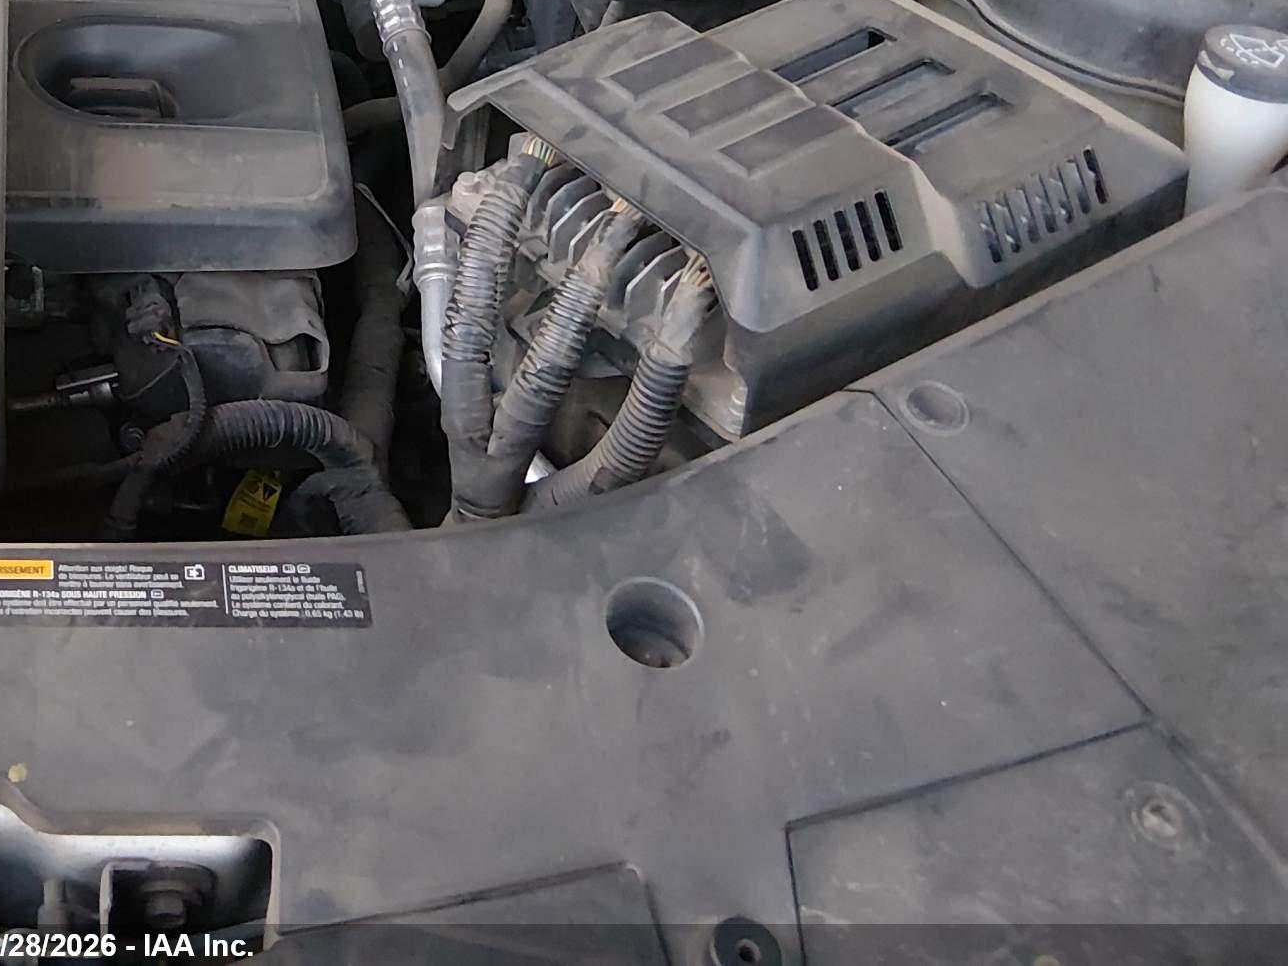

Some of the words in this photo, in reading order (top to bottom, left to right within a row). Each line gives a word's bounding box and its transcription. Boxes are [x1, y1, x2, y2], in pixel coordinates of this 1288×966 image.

[228, 565, 278, 573] CLIMATISEUR
[61, 590, 82, 599] SOUS
[82, 590, 108, 599] HAUTE
[108, 590, 147, 599] PRESSION
